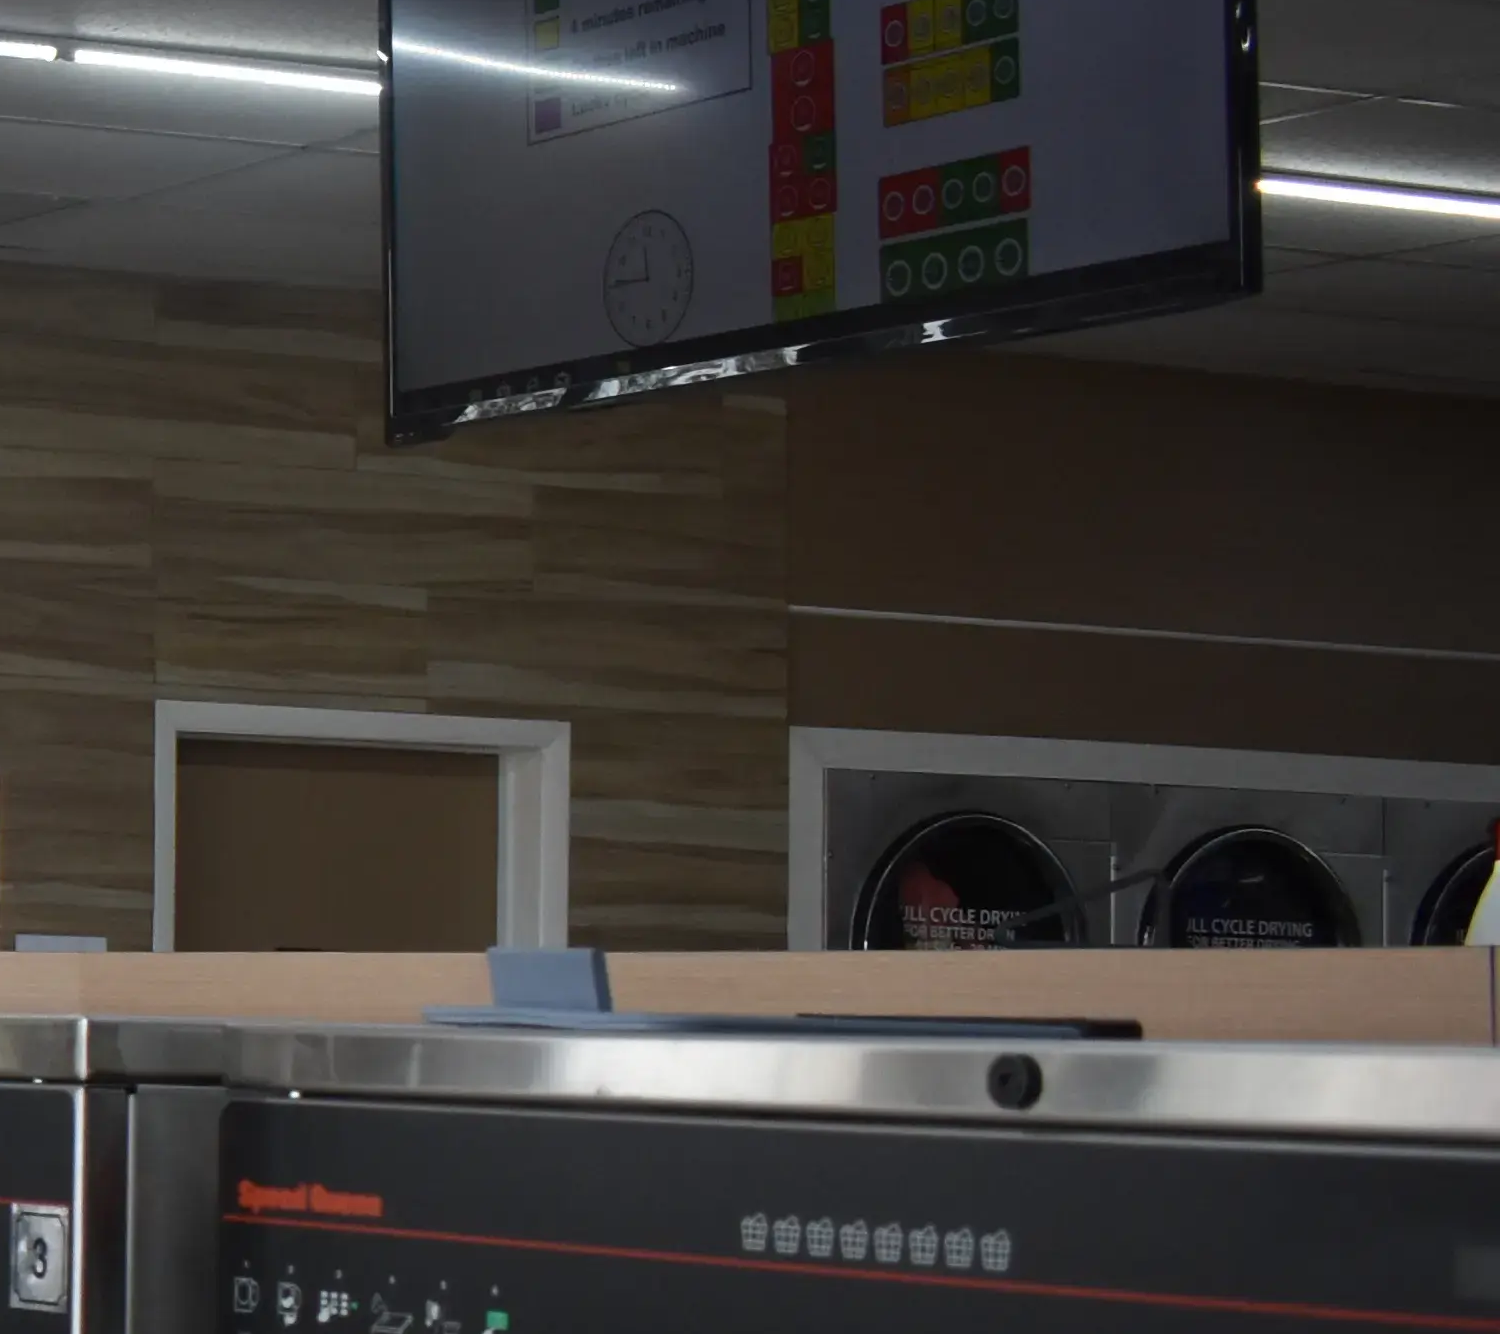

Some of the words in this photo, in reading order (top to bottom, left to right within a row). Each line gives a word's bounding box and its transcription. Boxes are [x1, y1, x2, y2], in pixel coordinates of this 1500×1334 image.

[582, 7, 634, 33] minutes
[666, 23, 726, 52] machine
[930, 907, 977, 924] CYCLE
[930, 926, 975, 940] BETTER
[1211, 918, 1256, 935] CYCLE
[1258, 920, 1313, 938] DRYING
[33, 1237, 47, 1279] 3
